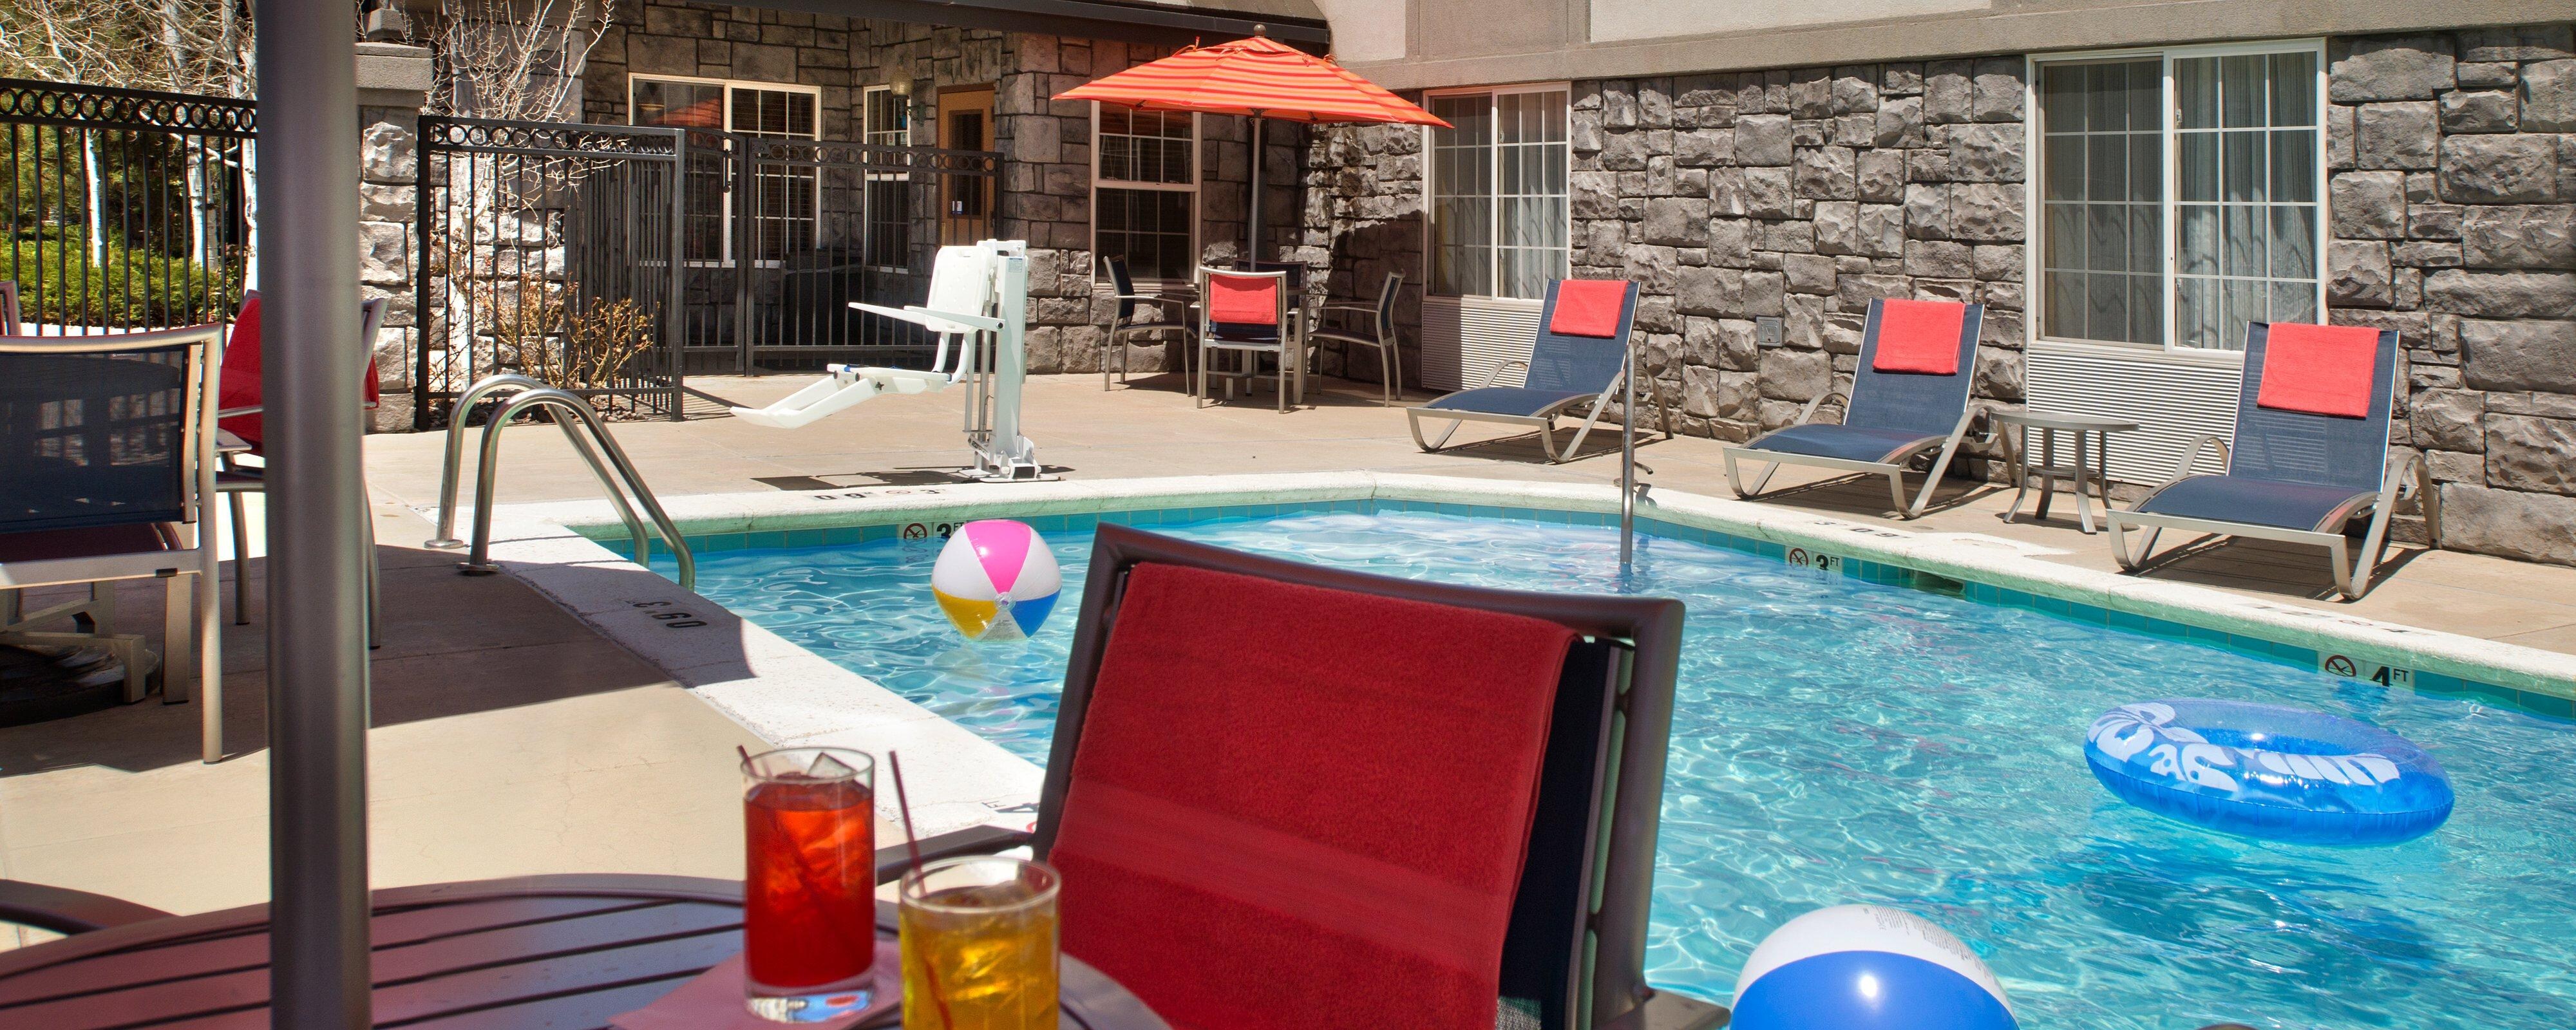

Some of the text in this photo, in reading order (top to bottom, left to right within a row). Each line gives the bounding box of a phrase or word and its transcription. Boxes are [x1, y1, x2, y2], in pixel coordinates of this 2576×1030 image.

[936, 523, 951, 538] 3
[1816, 555, 1840, 570] 3 FT
[2370, 666, 2409, 687] 4 FT
